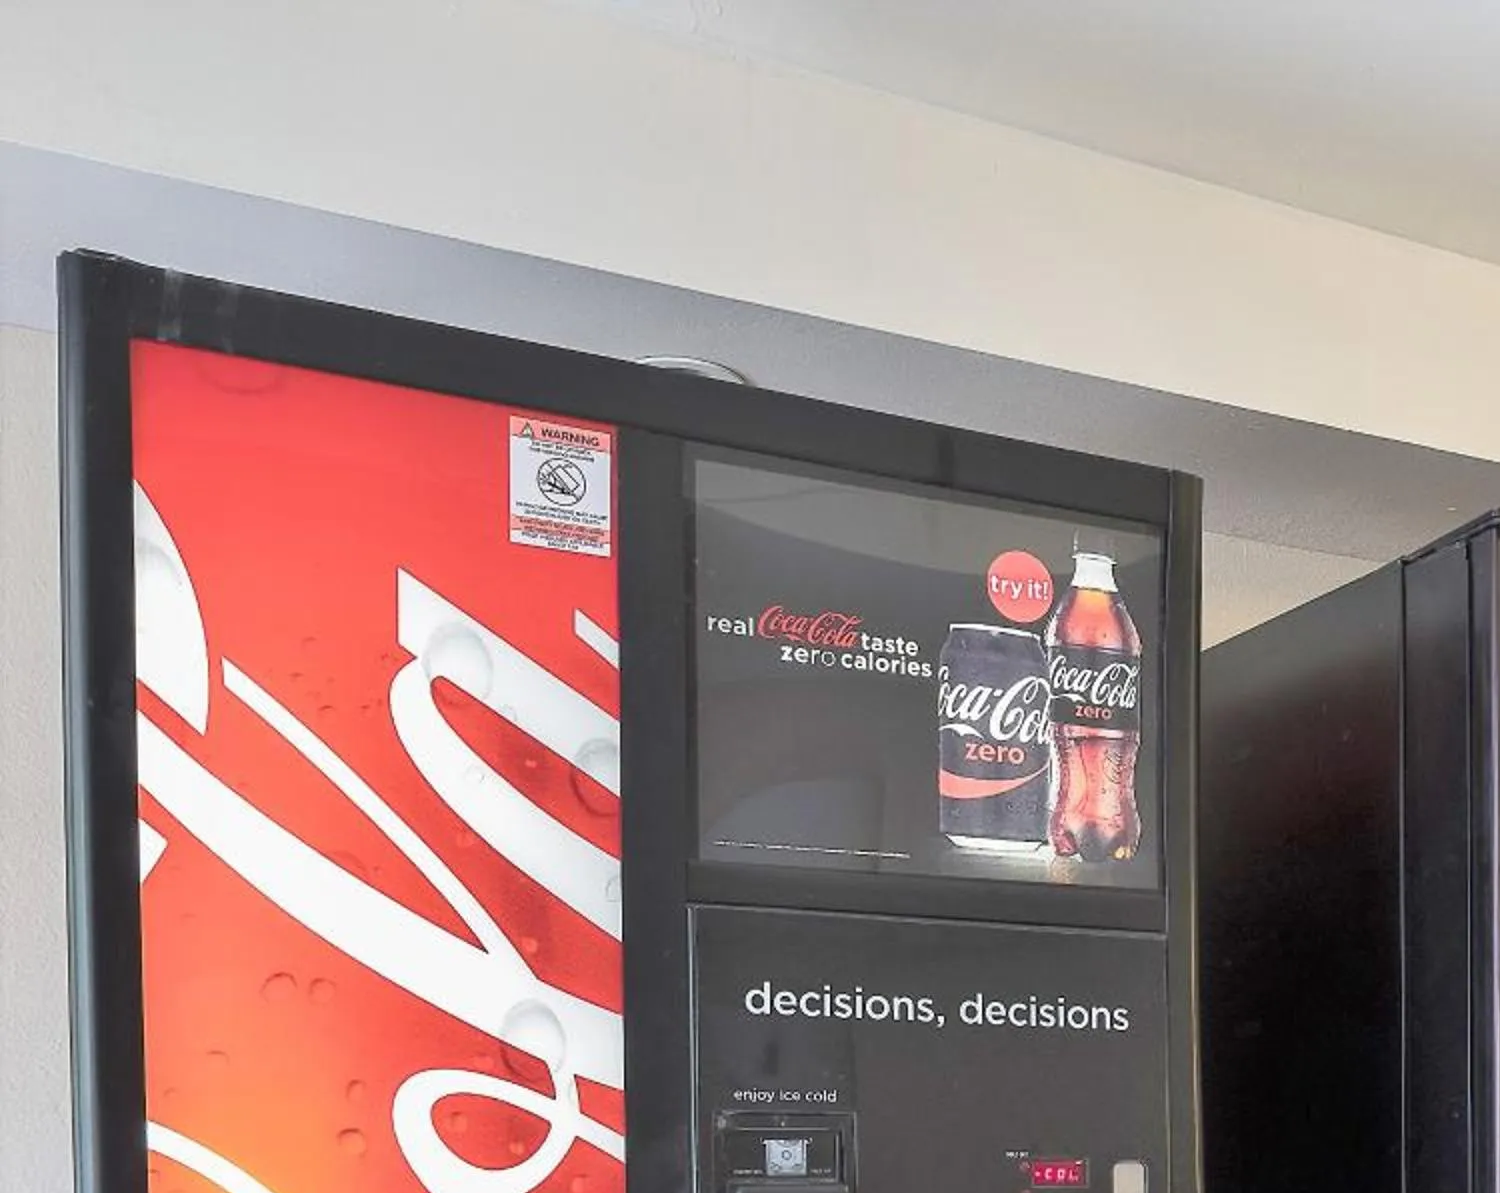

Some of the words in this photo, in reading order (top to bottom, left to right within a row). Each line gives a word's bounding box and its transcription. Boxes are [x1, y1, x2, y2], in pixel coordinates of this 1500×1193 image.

[541, 428, 600, 447] WARNING
[989, 577, 1024, 599] try
[1028, 581, 1050, 600] it!
[707, 615, 754, 637] real
[861, 632, 919, 657] taste
[780, 645, 837, 667] zero
[840, 651, 933, 678] calories
[1074, 703, 1113, 720] zero
[964, 740, 1025, 765] zero
[744, 981, 946, 1028] decisions,
[958, 993, 1130, 1031] decisions
[733, 1088, 775, 1103] enjoy
[779, 1088, 801, 1102] ice
[805, 1088, 838, 1103] cold
